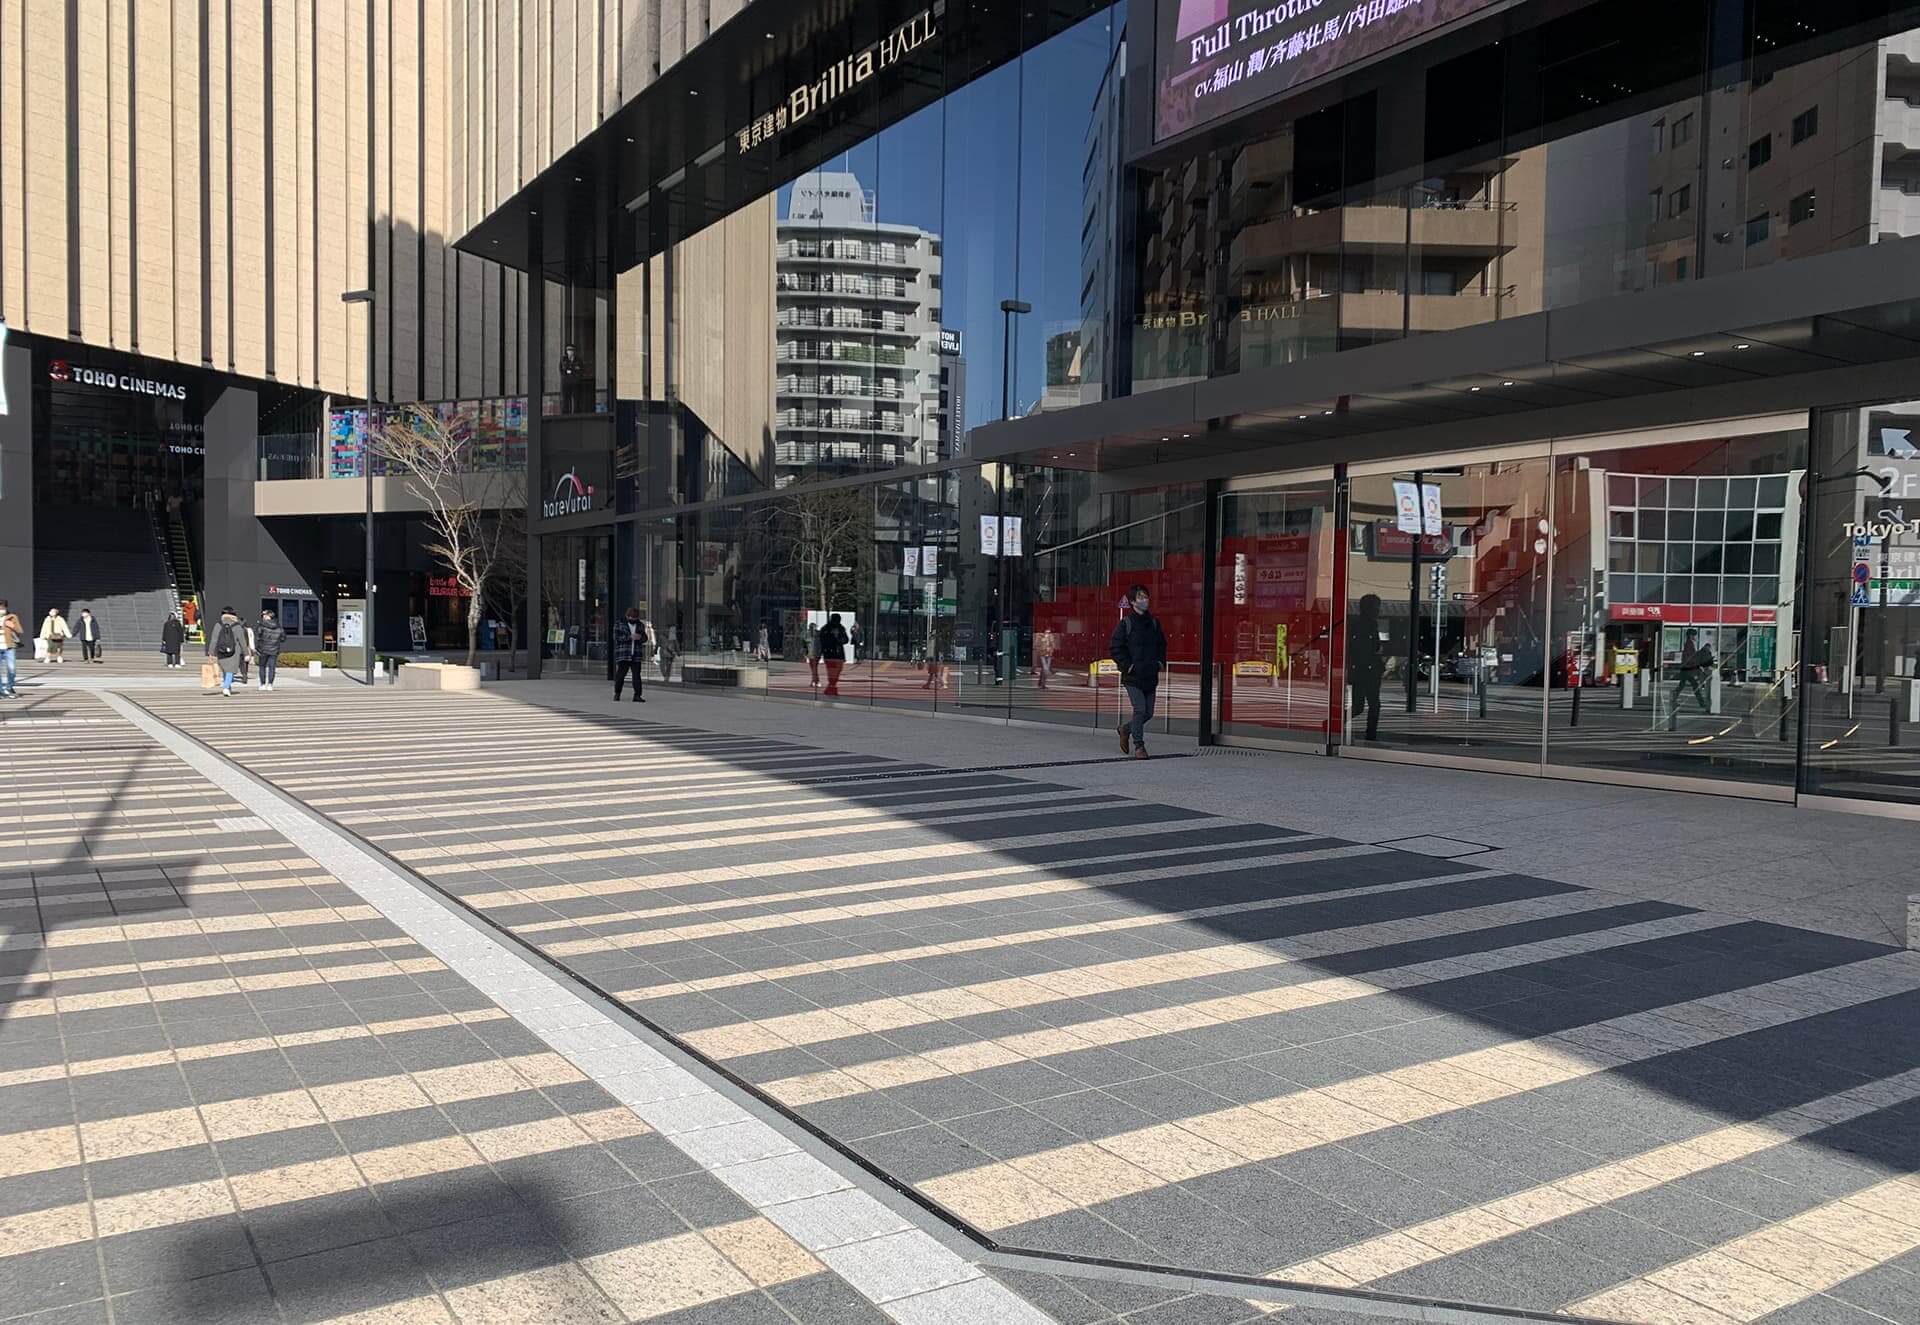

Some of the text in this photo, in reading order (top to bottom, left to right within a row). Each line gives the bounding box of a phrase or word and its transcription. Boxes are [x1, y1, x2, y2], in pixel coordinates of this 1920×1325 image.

[1190, 24, 1231, 64] Full
[738, 104, 788, 154] 東京建物
[790, 50, 874, 124] Brillia
[879, 11, 937, 69] HALL
[1257, 306, 1300, 321] HALL
[72, 367, 187, 400] TOHO CINEMAS
[169, 445, 193, 455] TOHO
[1877, 467, 1918, 499] 2F
[1843, 520, 1905, 541] Tokyo
[276, 587, 290, 595] TOHO
